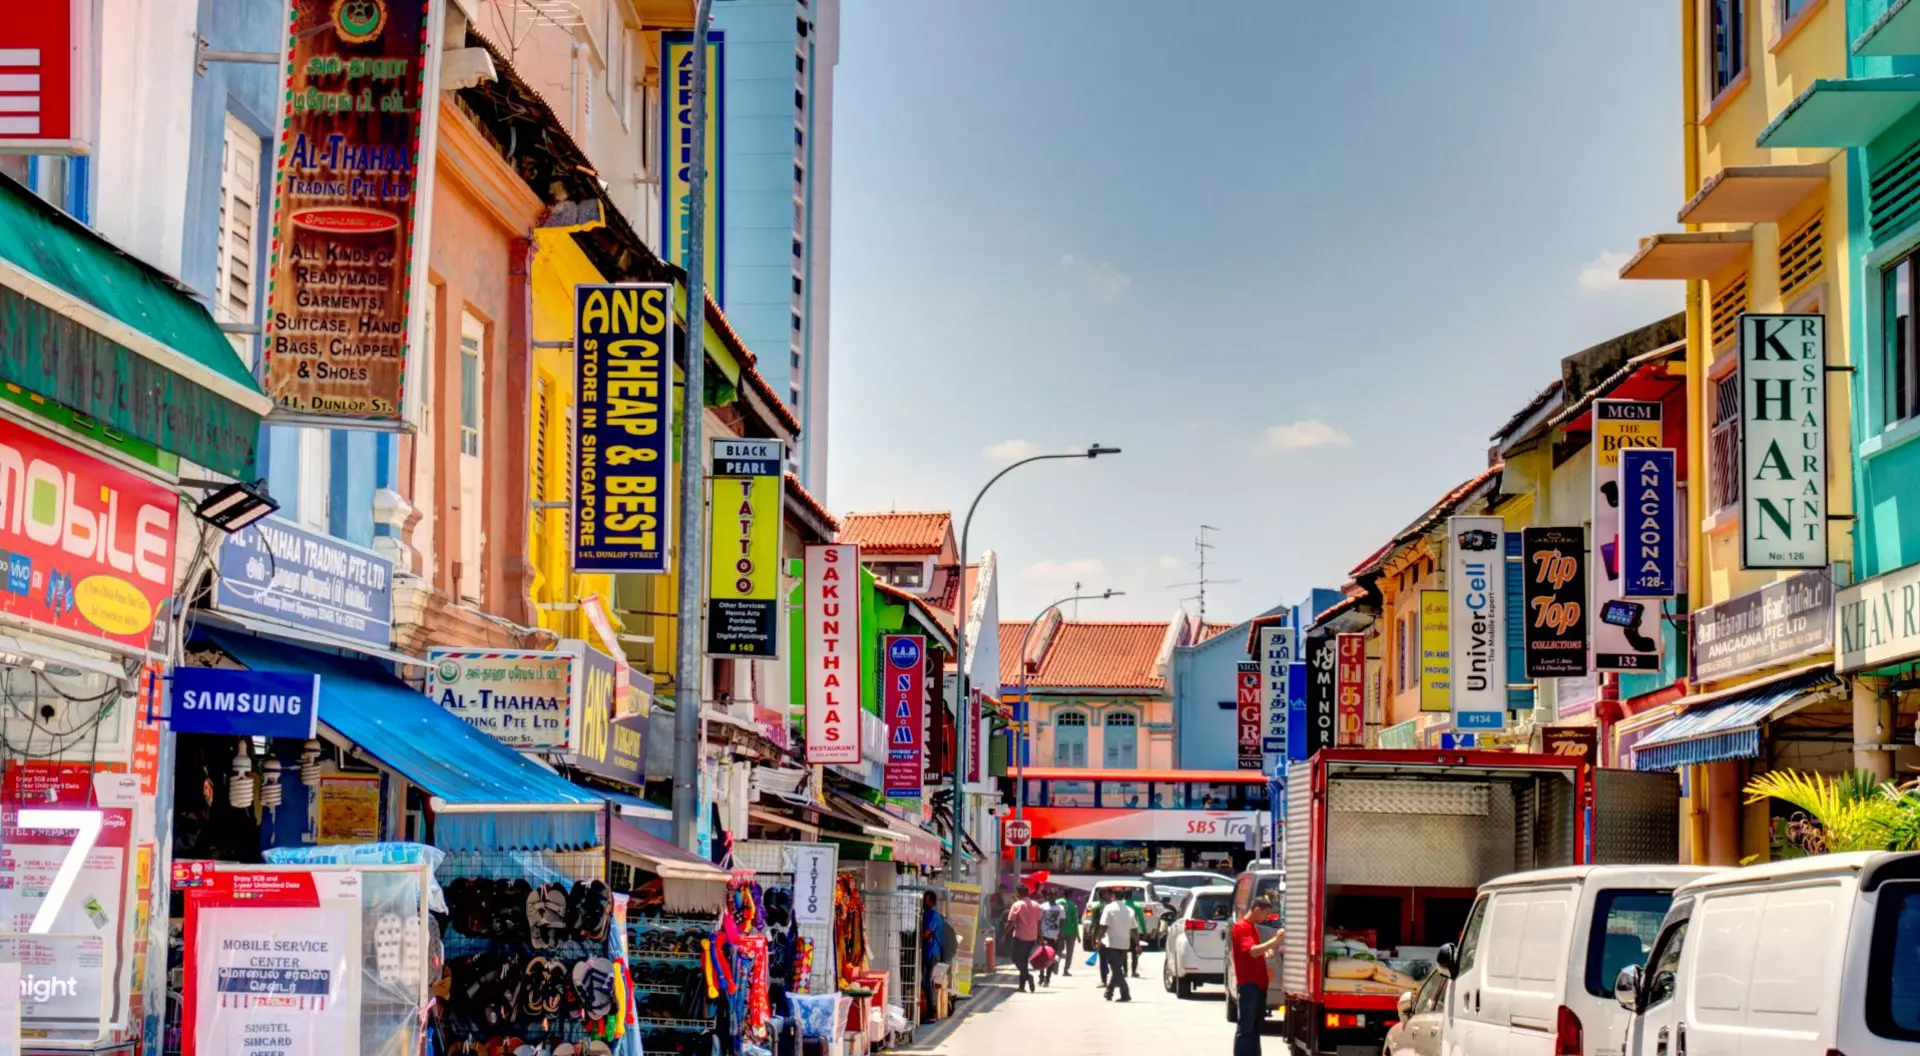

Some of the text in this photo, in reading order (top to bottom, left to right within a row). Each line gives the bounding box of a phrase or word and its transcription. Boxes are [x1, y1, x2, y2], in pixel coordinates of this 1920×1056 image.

[289, 133, 410, 170] AL-THAHAA
[288, 175, 408, 197] TRADING PTE LTD
[289, 243, 395, 262] ALL KINDS OF
[296, 267, 386, 286] READYMADE
[275, 312, 400, 334] SUITCASE, HAND
[582, 290, 665, 335] ANS
[276, 337, 398, 358] BAGS, CHAPPEL
[297, 361, 367, 380] & SHOES
[312, 396, 365, 412] DUNLOP
[1608, 405, 1652, 419] MGM
[1618, 425, 1641, 433] THE
[1751, 318, 1798, 541] KHAN
[1800, 318, 1820, 541] RESTAURANT
[580, 339, 598, 547] STORE IN SINGAPORE
[604, 339, 660, 550] CHEAP & BEST
[726, 445, 767, 457] BLACK
[1602, 435, 1658, 451] BOSS
[726, 462, 767, 474] PEARL
[1640, 460, 1660, 573] ANACAONA
[736, 481, 753, 594] TATTOO
[256, 524, 301, 564] THAHAA
[304, 539, 348, 578] TRADING
[349, 556, 366, 584] PTE
[597, 551, 628, 560] DUNLOP
[629, 552, 660, 560] STREET
[1788, 552, 1805, 561] 126
[1533, 549, 1577, 590] Tip
[1531, 594, 1581, 636] Top
[1841, 589, 1895, 654] KHAN
[1466, 562, 1488, 692] UniverCell
[1488, 592, 1497, 662] The Mobile Expert
[822, 549, 841, 741] SAKUNTHALAS
[1532, 640, 1583, 649] COLLECTIONS
[1708, 631, 1763, 660] ANACAONA
[1764, 623, 1785, 641] PTE
[1786, 617, 1807, 634] LTD
[1618, 656, 1637, 667] 132
[183, 690, 301, 715] SAMSUNG
[440, 688, 560, 711] AL-THAHAA
[503, 714, 527, 728] PTE
[534, 714, 559, 728] LTD
[581, 664, 612, 763] ANS
[1469, 714, 1491, 724] #134
[1006, 827, 1030, 839] STOP
[1186, 820, 1216, 834] SBS
[807, 856, 819, 914] TATTOO
[223, 940, 328, 952] MOBILE SERVICE
[250, 957, 300, 968] CENTER
[245, 1023, 291, 1033] SINGTEL
[244, 1037, 292, 1047] SIMCARD
